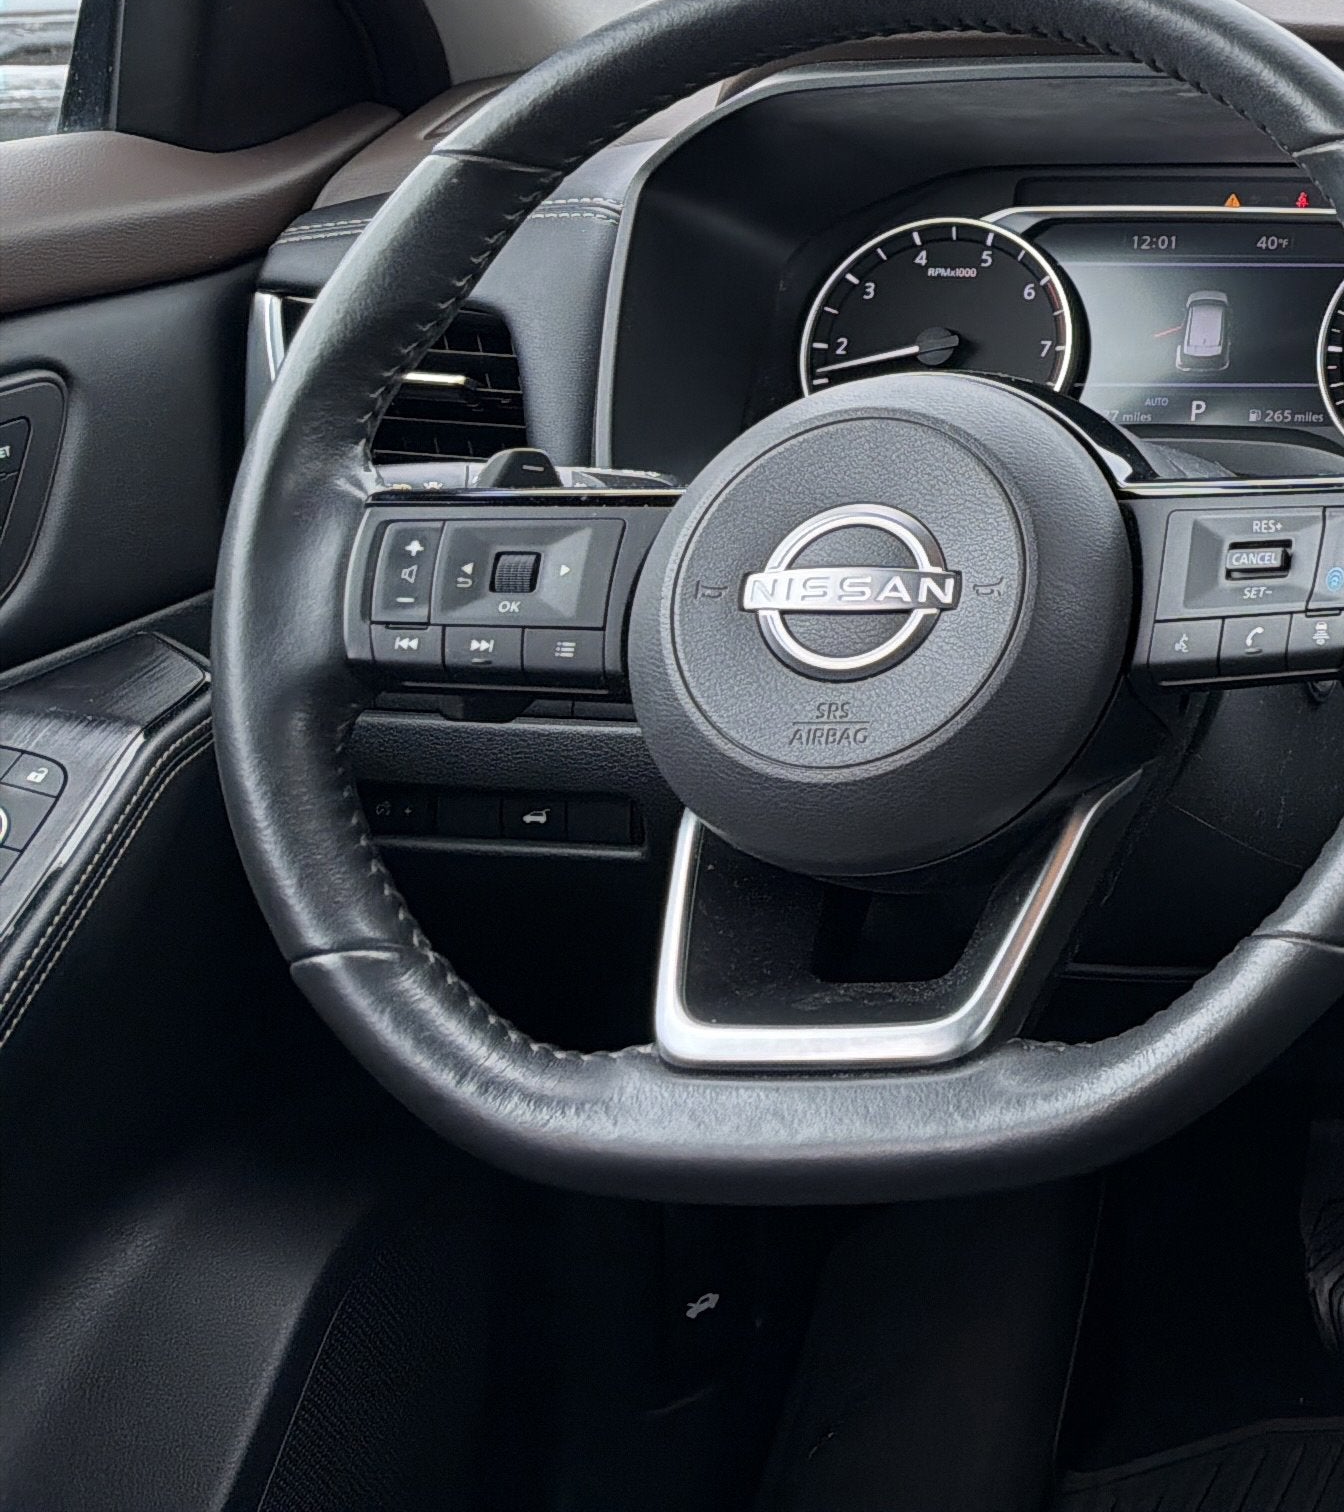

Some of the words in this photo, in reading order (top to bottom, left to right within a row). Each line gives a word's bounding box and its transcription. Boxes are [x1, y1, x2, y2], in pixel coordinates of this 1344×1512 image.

[1132, 235, 1177, 250] 12:01
[914, 249, 928, 267] 4
[980, 250, 993, 267] 5
[862, 282, 875, 300] 3
[1023, 283, 1036, 300] 6
[835, 337, 848, 355] 2
[1040, 340, 1052, 357] 7
[1144, 397, 1169, 406] AUTO
[1122, 411, 1152, 422] miles
[1190, 400, 1206, 421] P
[1264, 410, 1292, 423] 265
[1294, 411, 1324, 423] miles
[1252, 520, 1283, 534] RES+
[1231, 551, 1278, 567] CANCEL
[751, 575, 956, 604] NISSAN
[498, 600, 521, 614] OK
[816, 701, 851, 720] SRS
[788, 727, 870, 747] AIRBAG
